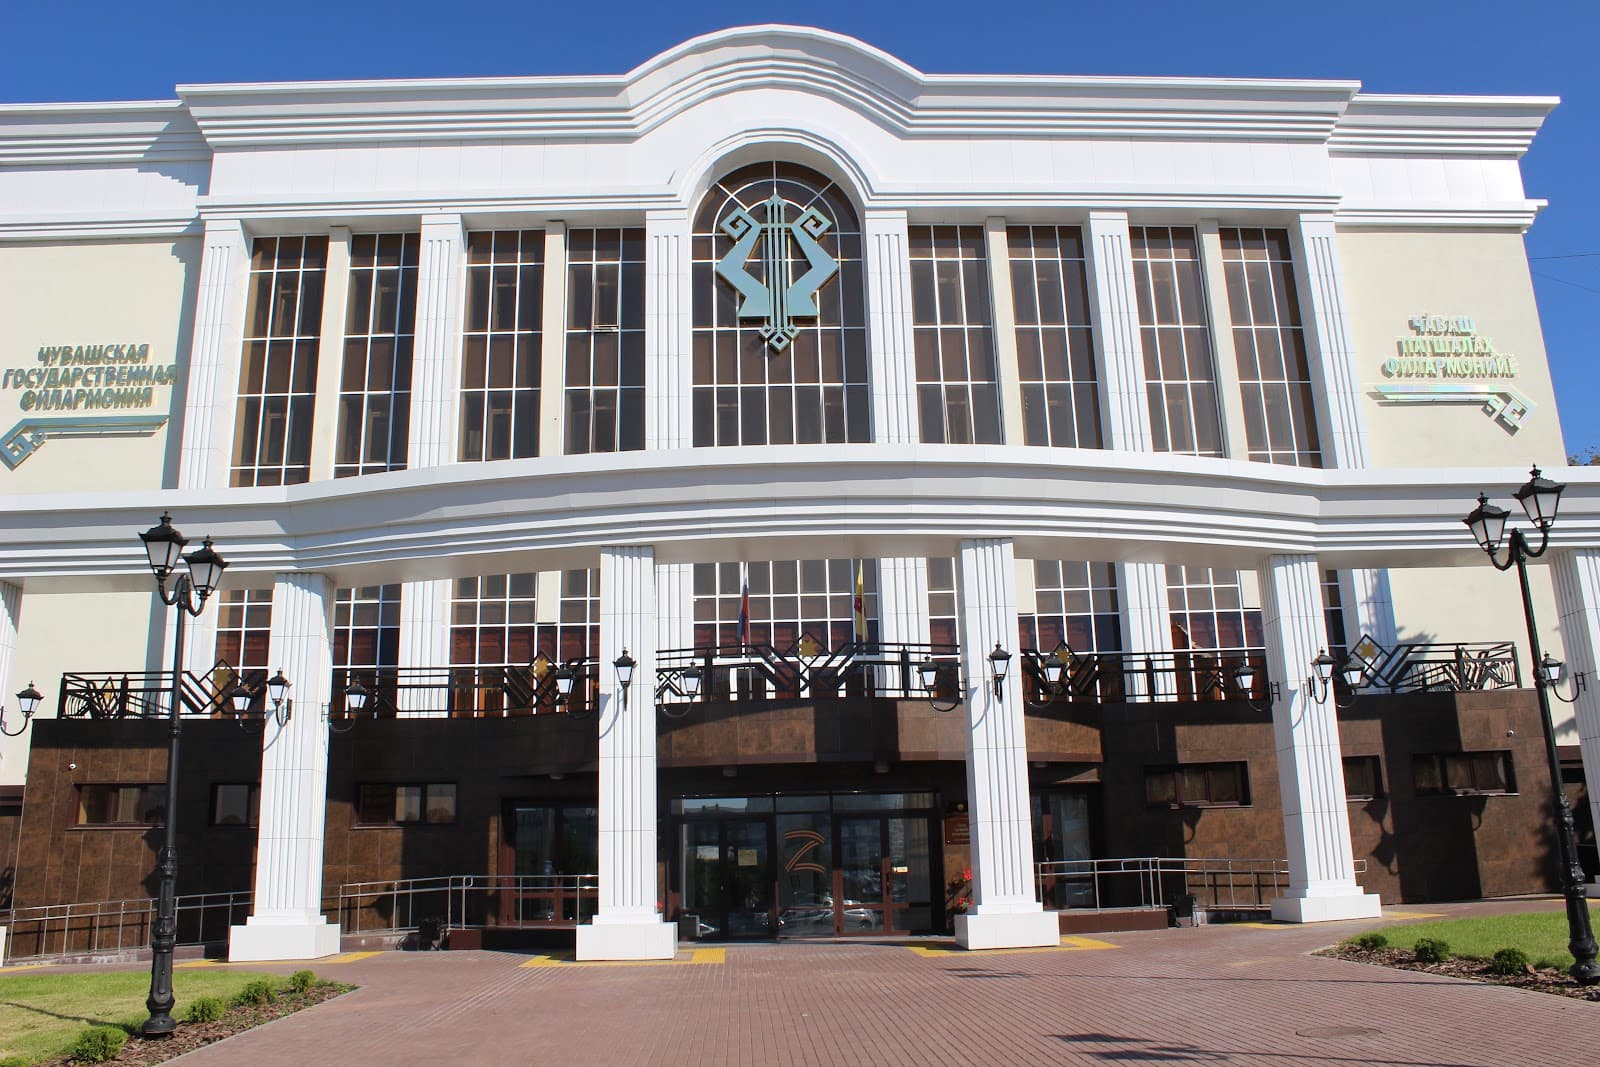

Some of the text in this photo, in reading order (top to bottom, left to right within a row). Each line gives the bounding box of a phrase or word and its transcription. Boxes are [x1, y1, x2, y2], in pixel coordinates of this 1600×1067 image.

[38, 343, 150, 366] ЧУВАШСКАЯ
[2, 364, 179, 389] ГОСУДАРСТВЕННАЯ
[19, 387, 153, 411] ФИЛАРМОНИЯ
